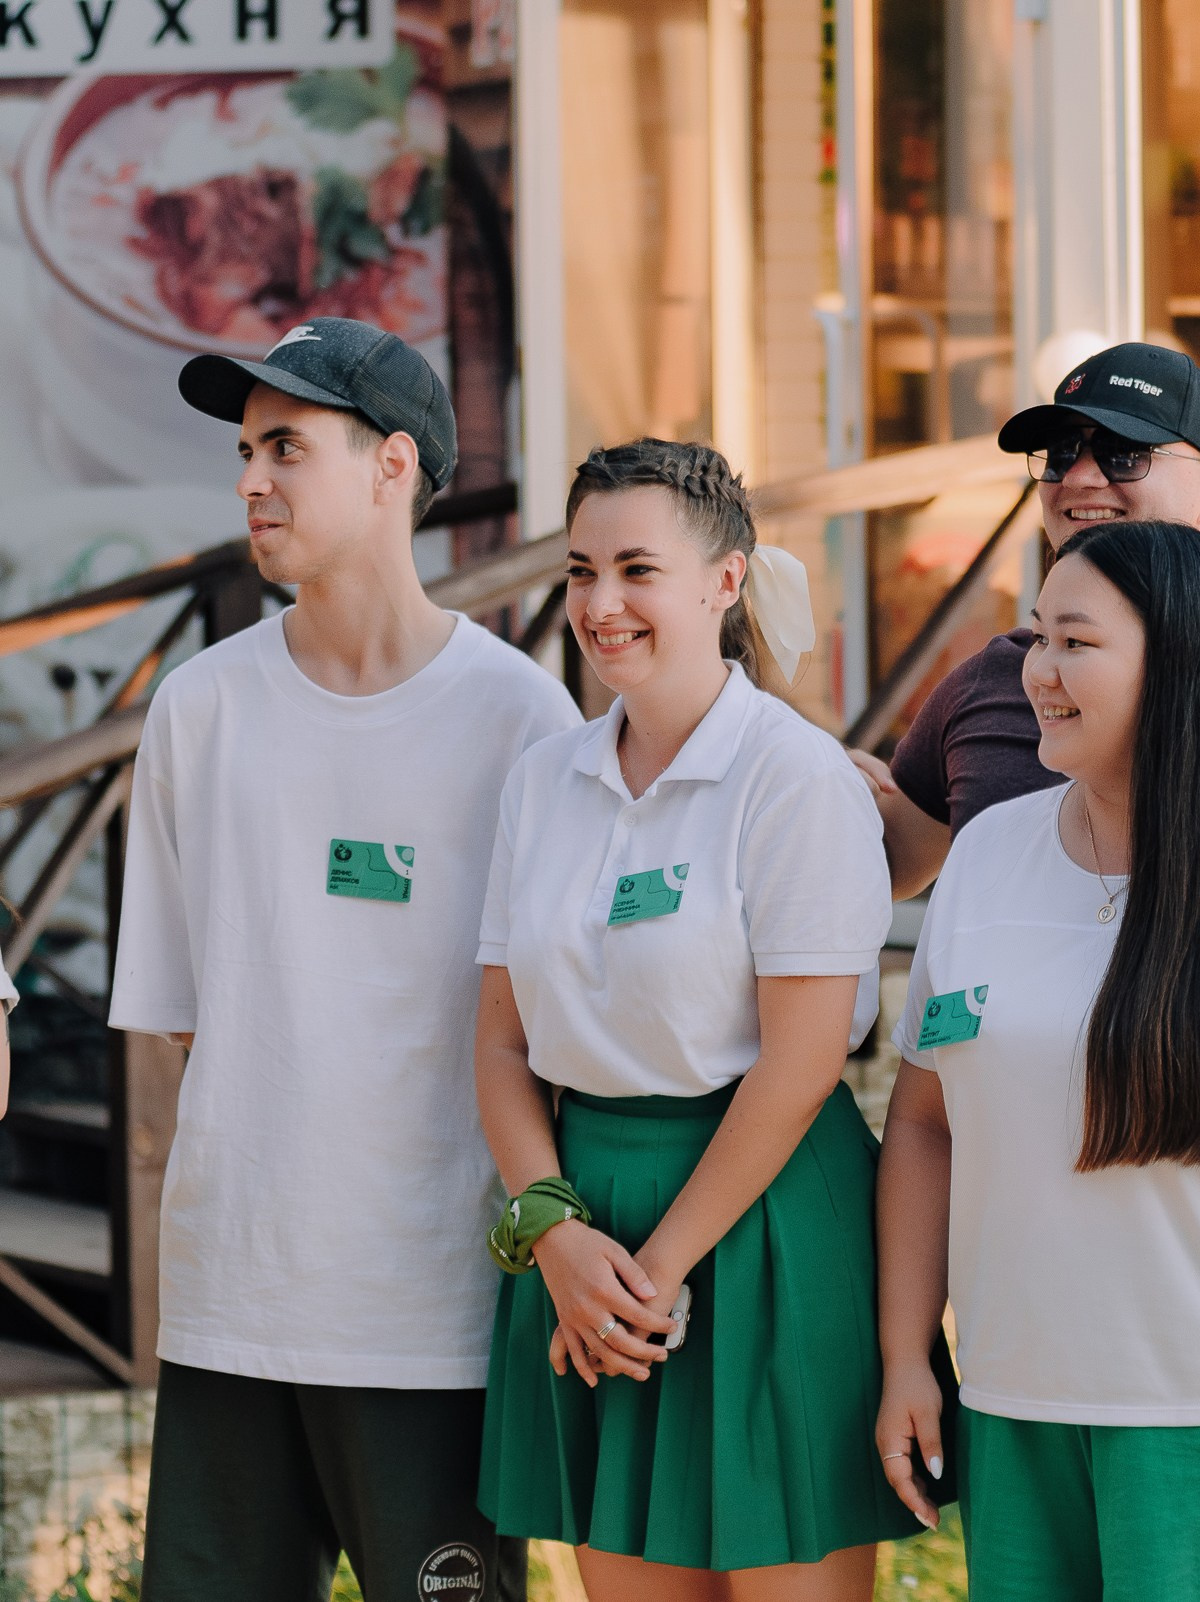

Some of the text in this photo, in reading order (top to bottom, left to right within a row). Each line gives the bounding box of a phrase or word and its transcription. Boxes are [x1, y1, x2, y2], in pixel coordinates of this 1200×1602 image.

[1109, 374, 1163, 397] Red Tiger
[428, 1548, 479, 1572] LEGENDARY QUALITY
[423, 1571, 481, 1593] ORIGINAL
